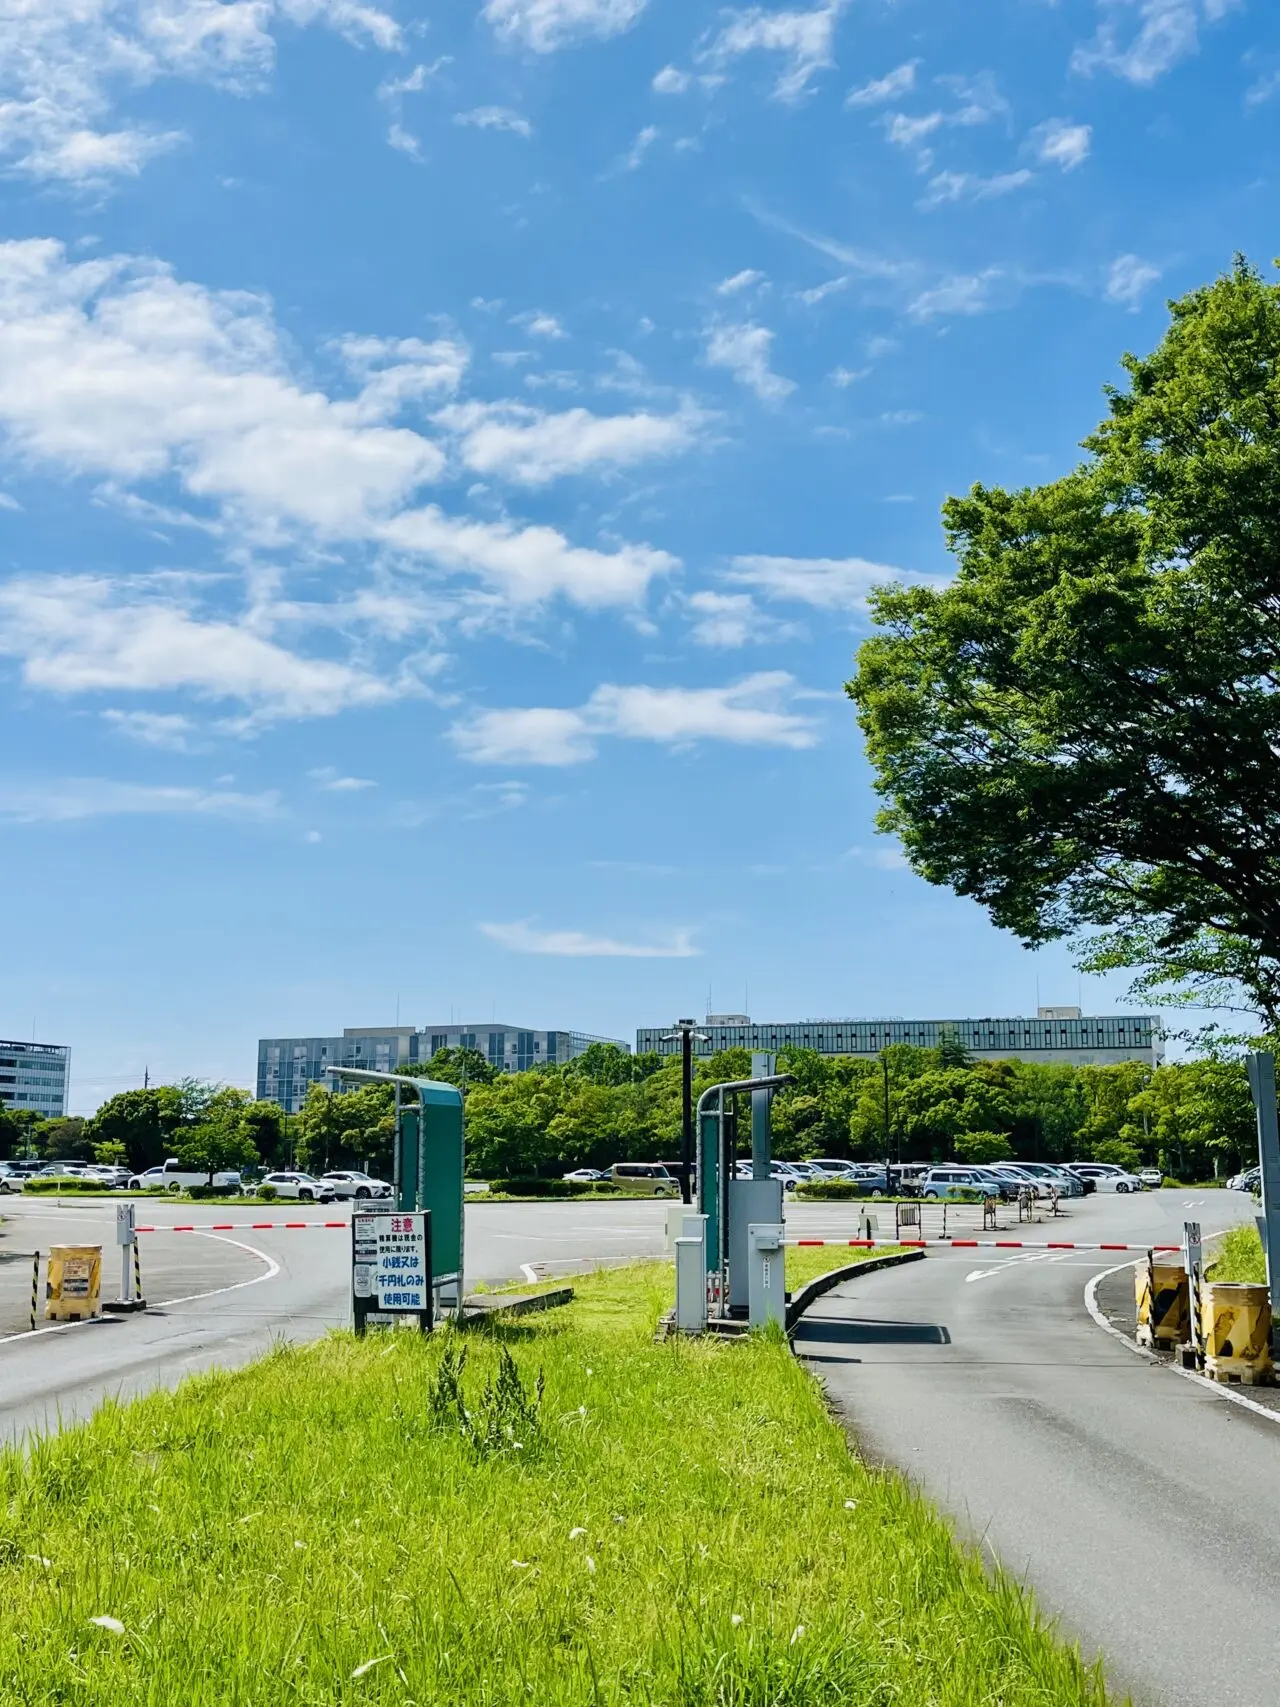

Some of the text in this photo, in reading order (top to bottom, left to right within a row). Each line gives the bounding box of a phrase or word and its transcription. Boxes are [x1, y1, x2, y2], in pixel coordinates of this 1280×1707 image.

[391, 1218, 413, 1232] 注意
[383, 1256, 419, 1268] 小銭又は
[379, 1275, 424, 1287] 千円札のみ
[384, 1292, 420, 1305] 使用可能
